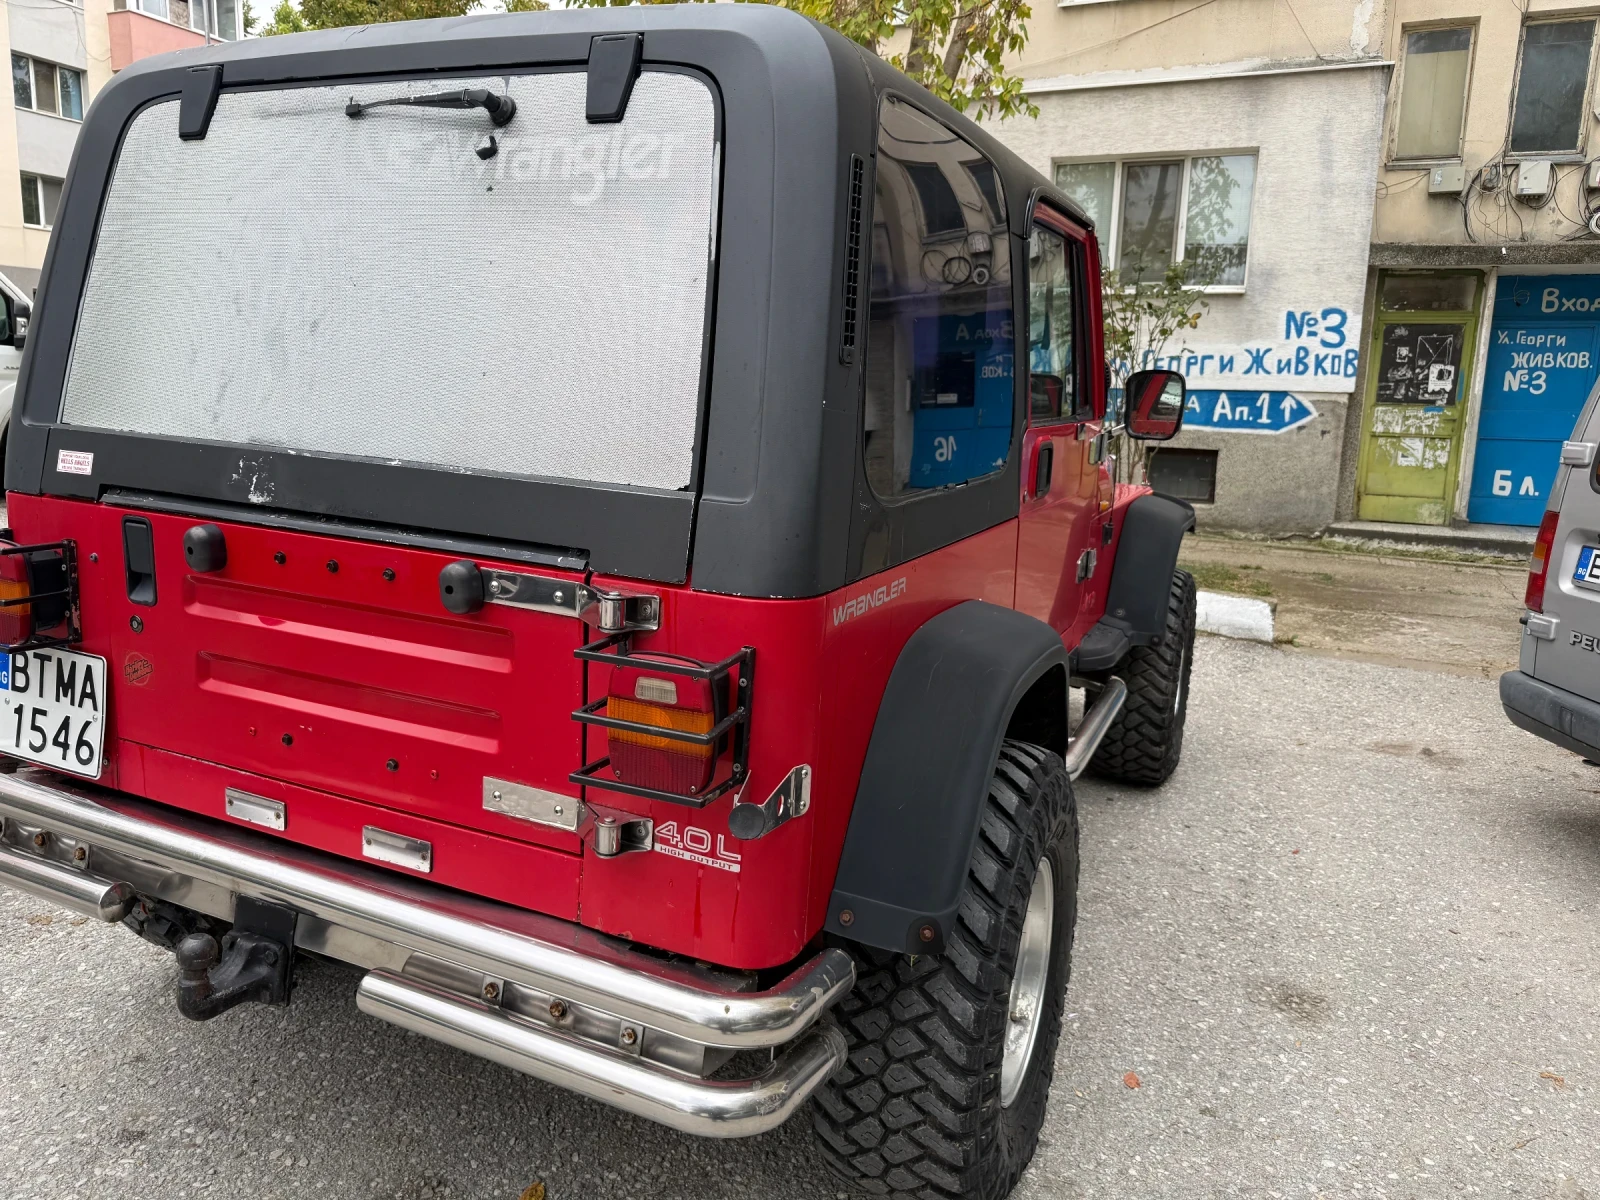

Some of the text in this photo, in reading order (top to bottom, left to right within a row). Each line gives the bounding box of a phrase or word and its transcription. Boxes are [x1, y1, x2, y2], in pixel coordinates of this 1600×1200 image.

[1285, 307, 1348, 349] №3
[1503, 370, 1547, 395] №3
[833, 577, 907, 626] WRANGLER
[11, 650, 98, 712] BTMA
[14, 703, 94, 766] 1546
[660, 845, 734, 871] HIGH OUTPUT
